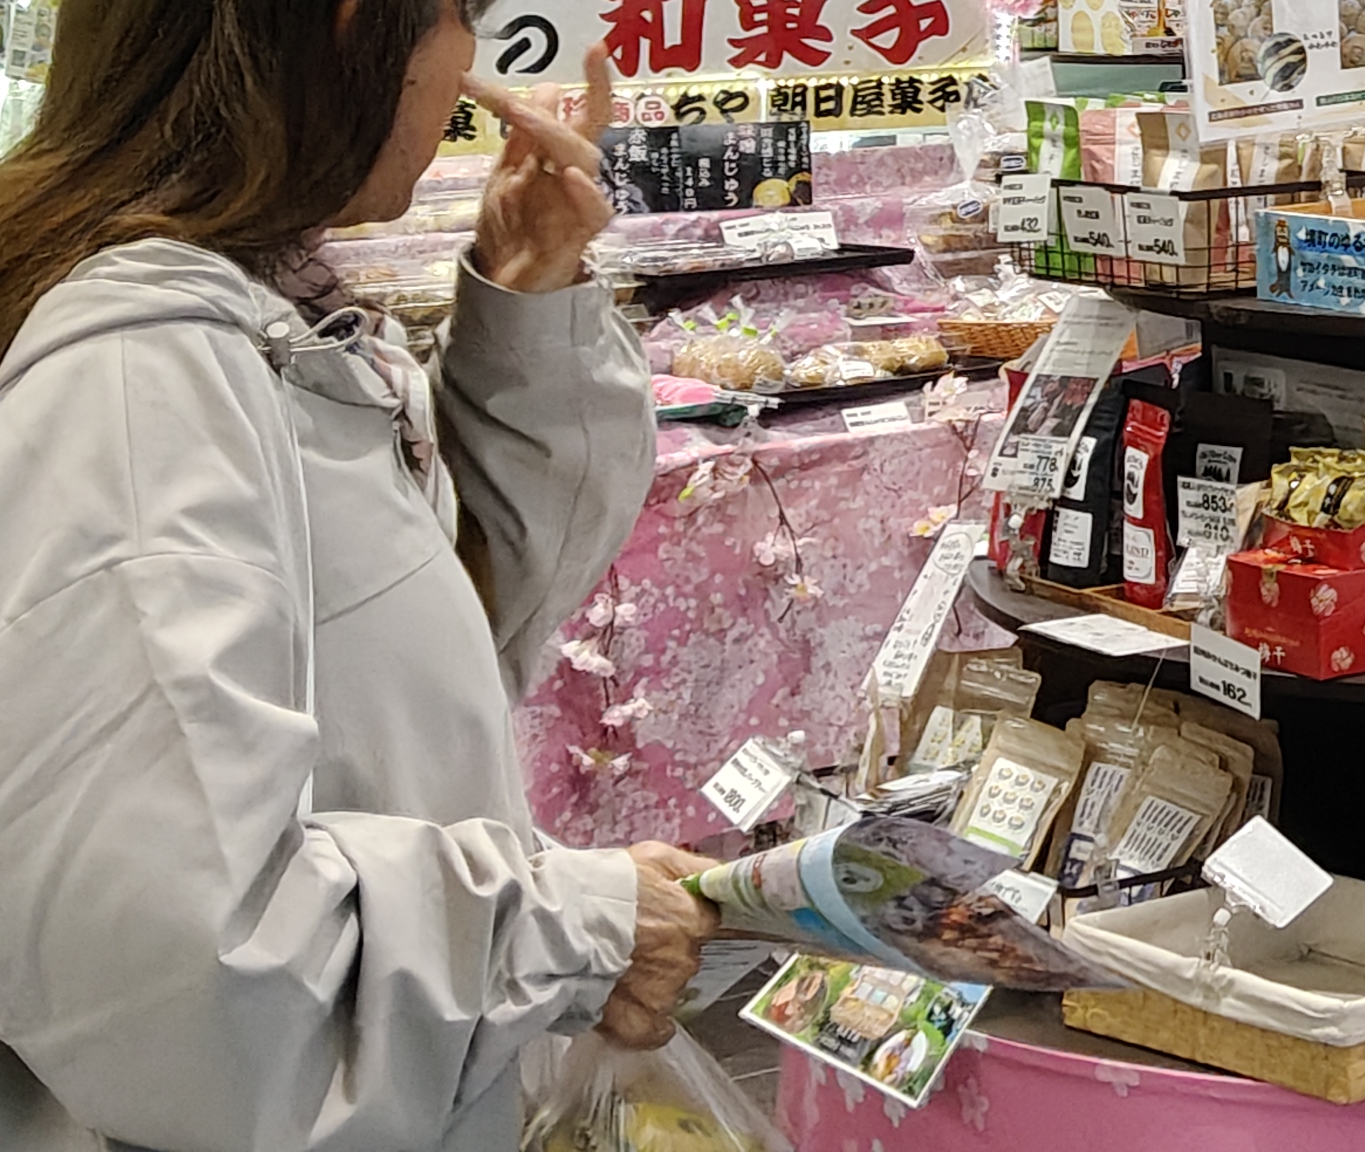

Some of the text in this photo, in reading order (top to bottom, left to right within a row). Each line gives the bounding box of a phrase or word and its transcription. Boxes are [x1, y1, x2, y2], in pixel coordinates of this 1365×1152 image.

[723, 133, 740, 207] まんじゅう
[1220, 679, 1248, 705] 162
